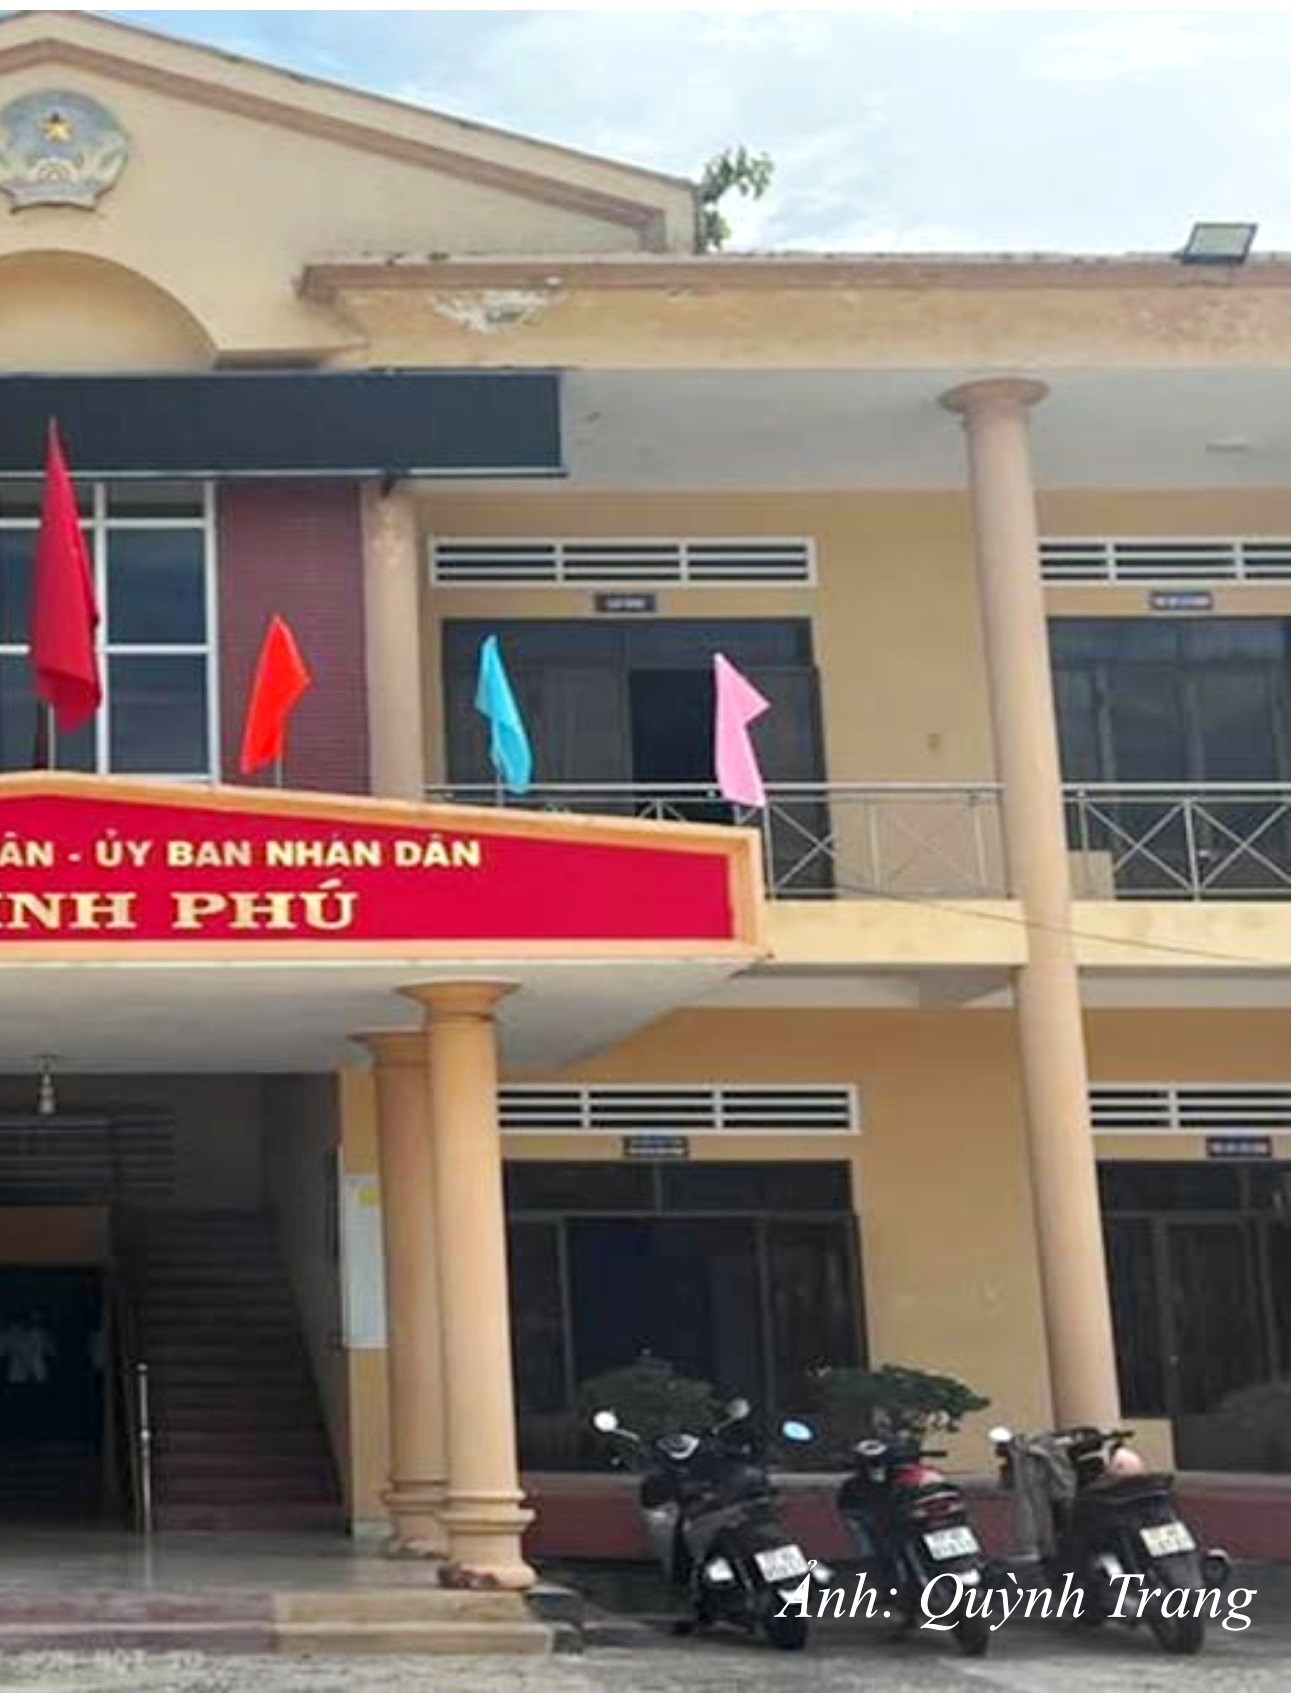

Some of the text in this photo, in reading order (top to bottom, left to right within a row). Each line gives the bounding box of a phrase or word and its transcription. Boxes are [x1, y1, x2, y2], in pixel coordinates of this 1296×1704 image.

[95, 828, 153, 868] ỦY
[167, 840, 253, 868] BAN
[394, 833, 481, 868] DÂN
[170, 878, 360, 930] PHÚ
